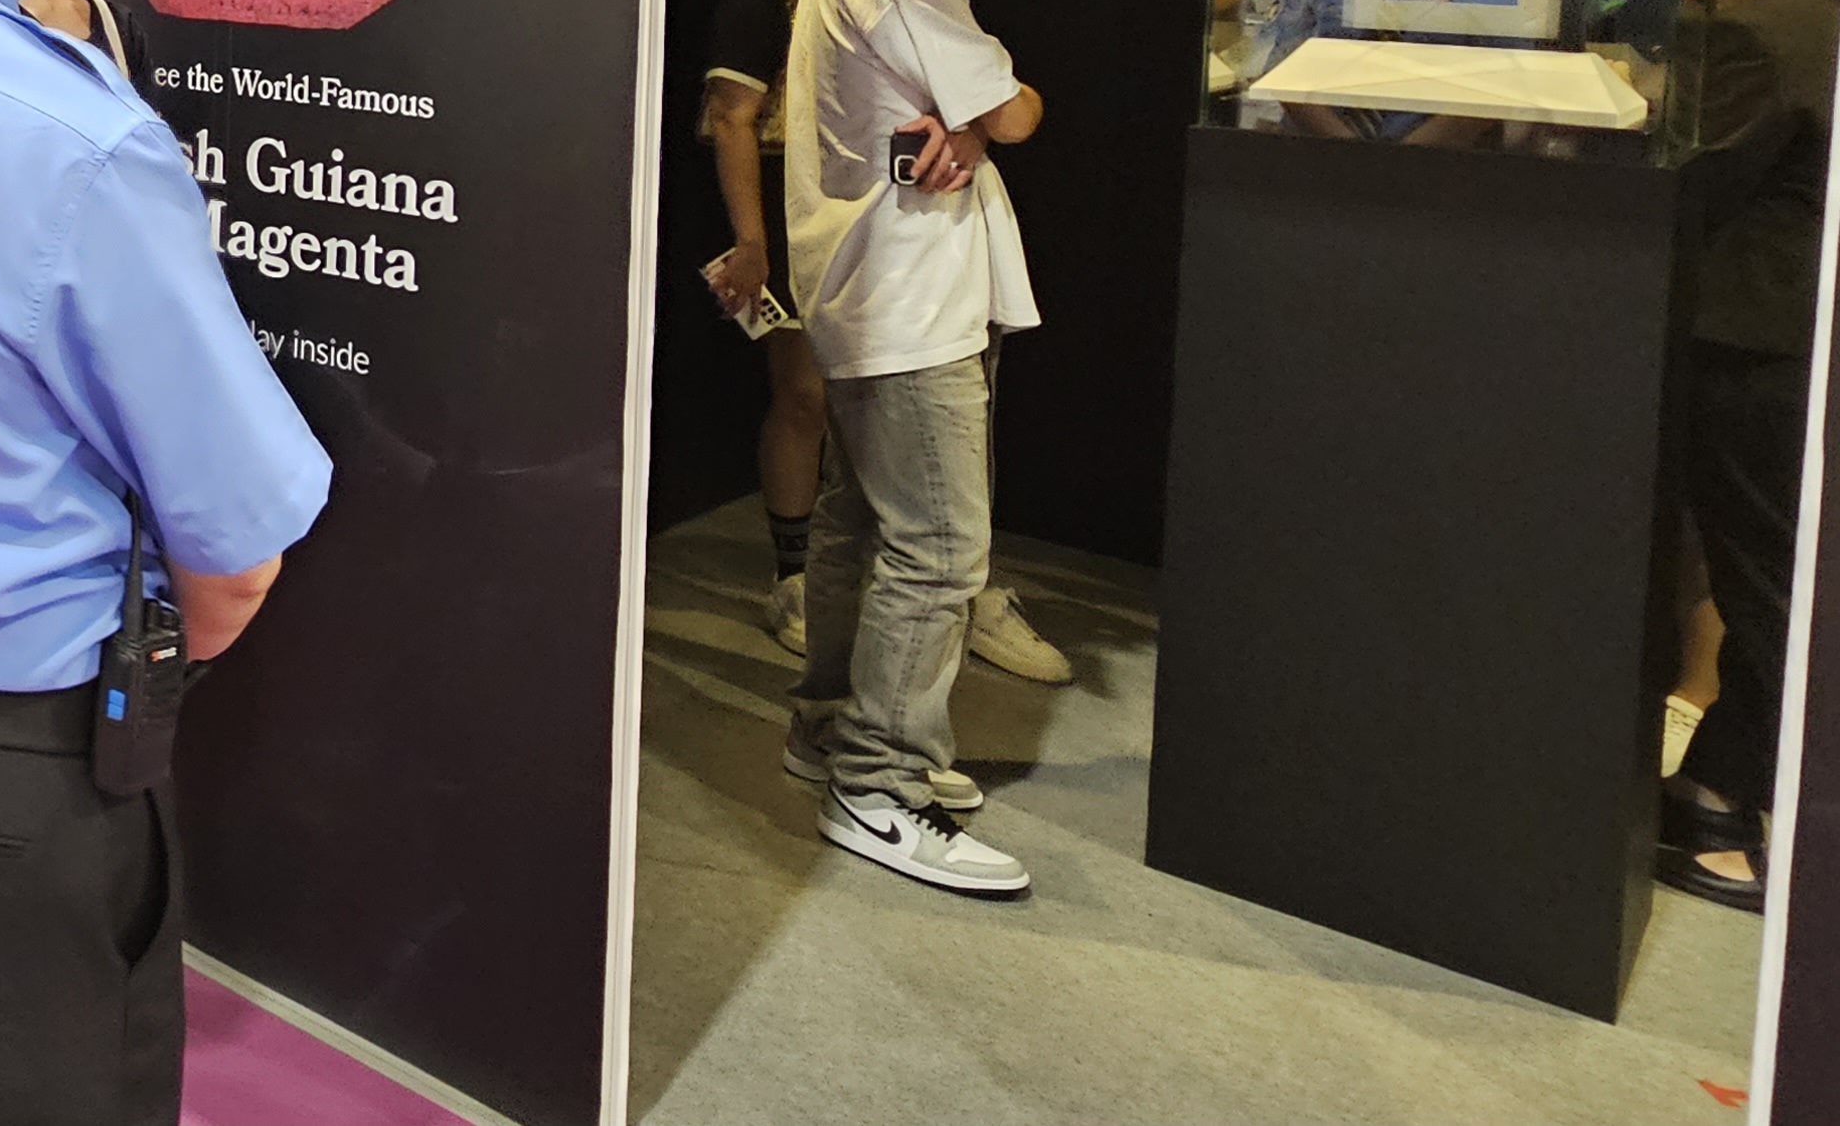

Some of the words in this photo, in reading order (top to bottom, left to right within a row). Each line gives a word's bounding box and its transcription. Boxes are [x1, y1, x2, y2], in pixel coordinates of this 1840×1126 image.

[154, 67, 181, 87] ee
[187, 63, 224, 93] the
[231, 67, 435, 119] World-Famous
[246, 136, 458, 223] Guiana
[293, 329, 370, 375] inside
